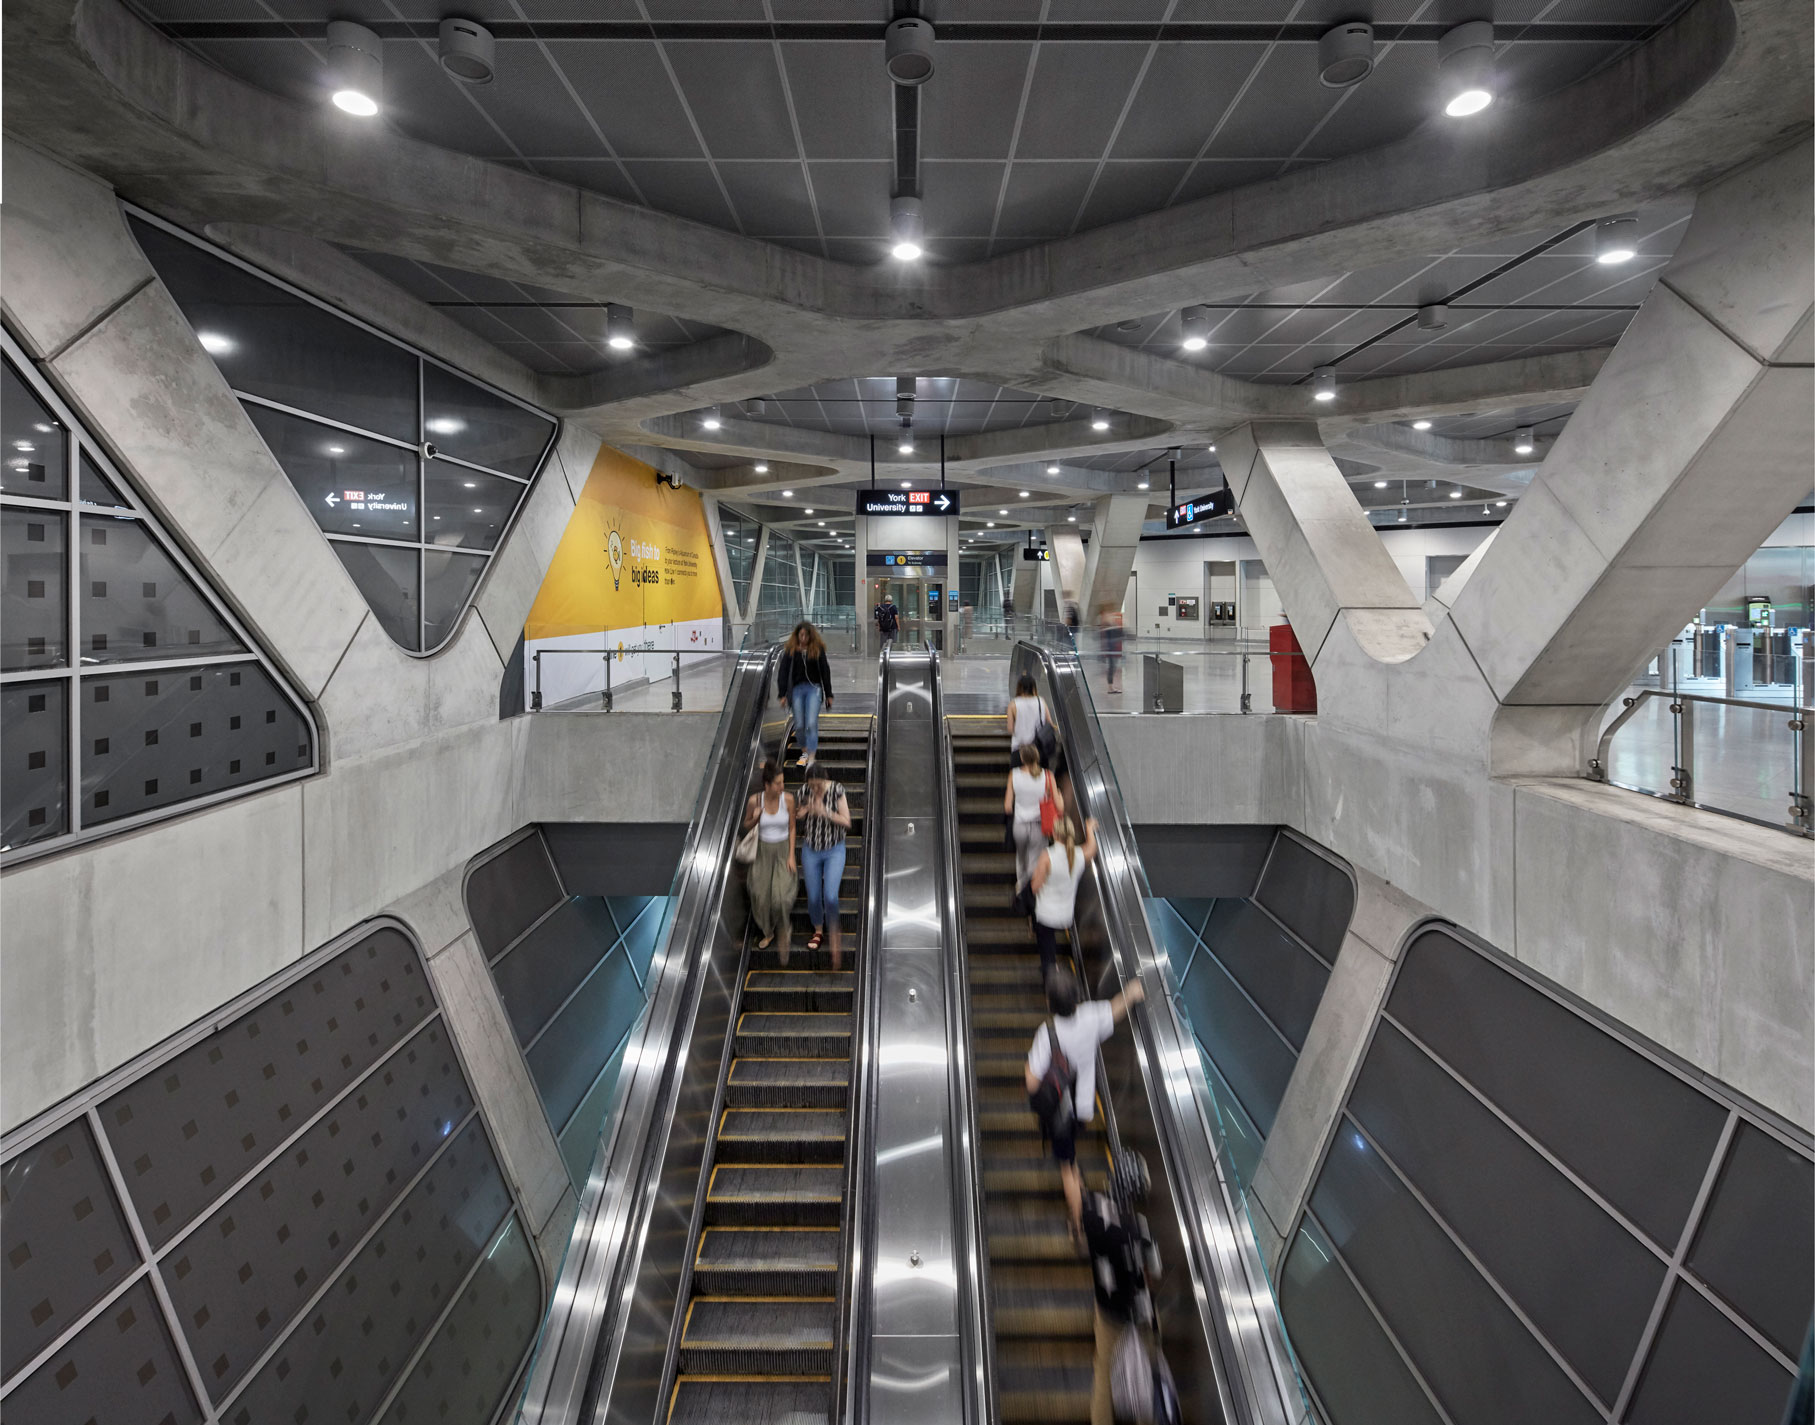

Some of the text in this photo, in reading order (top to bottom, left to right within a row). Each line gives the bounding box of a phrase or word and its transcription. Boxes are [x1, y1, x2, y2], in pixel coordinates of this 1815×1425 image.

[888, 493, 929, 502] York EXIT
[867, 503, 906, 513] University
[631, 539, 660, 563] Big fish to
[631, 566, 660, 588] big ideas
